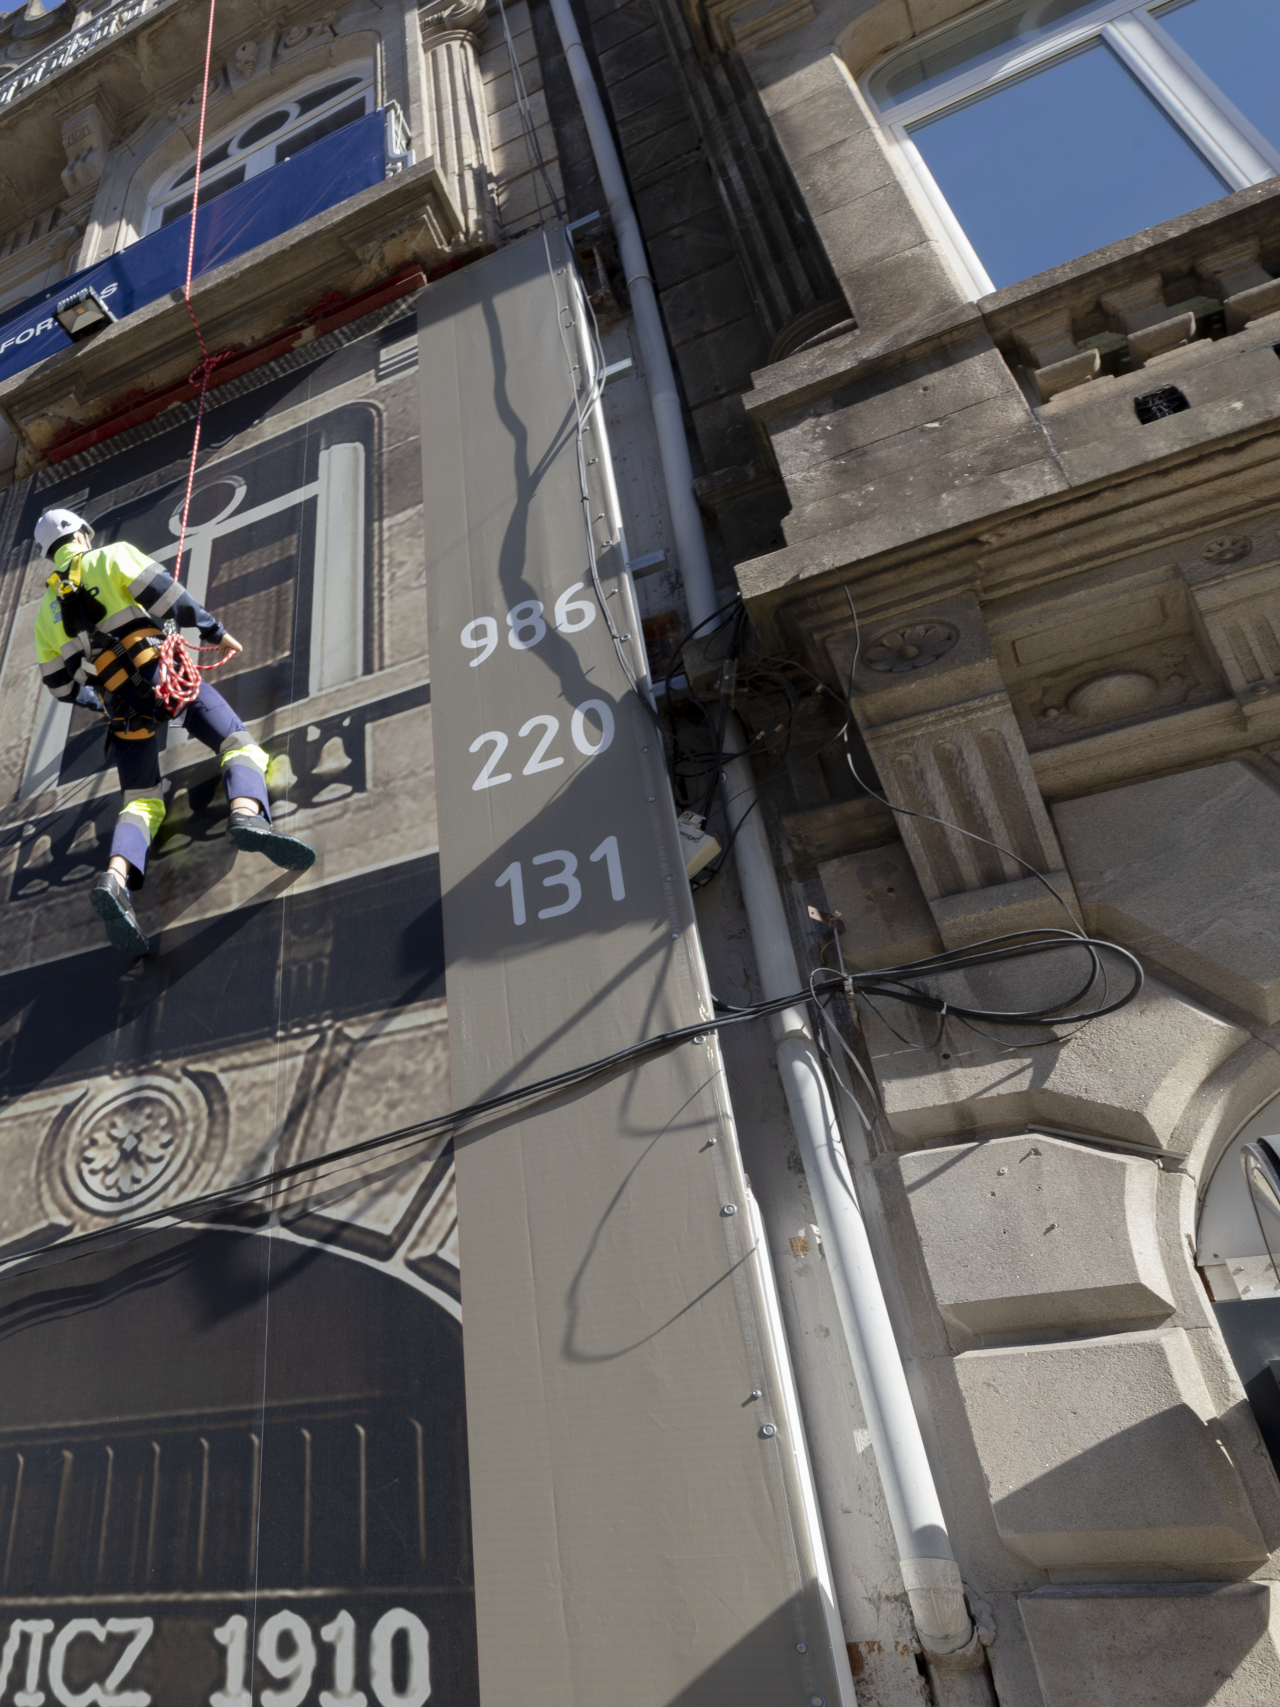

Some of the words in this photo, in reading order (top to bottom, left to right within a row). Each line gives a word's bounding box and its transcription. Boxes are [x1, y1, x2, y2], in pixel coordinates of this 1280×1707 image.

[460, 581, 597, 668] 986
[468, 698, 616, 792] 220
[494, 835, 626, 926] 131
[209, 1607, 432, 1707] 1910
